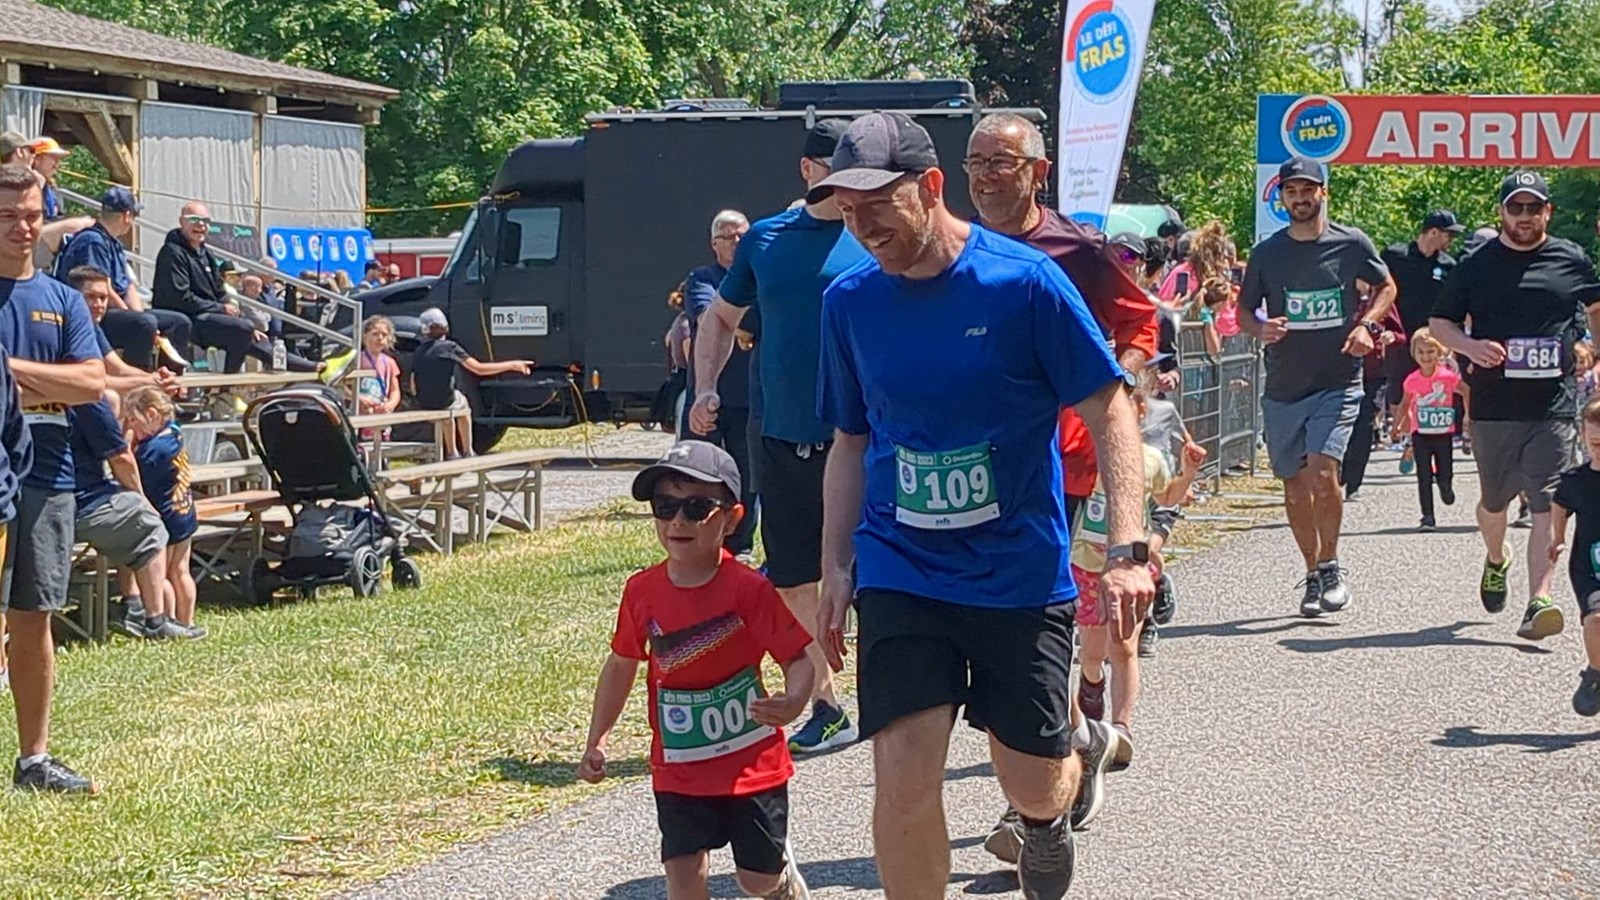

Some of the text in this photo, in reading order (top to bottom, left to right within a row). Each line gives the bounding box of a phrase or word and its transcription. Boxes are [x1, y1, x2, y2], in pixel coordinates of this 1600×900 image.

[1080, 21, 1117, 47] LE DÉFI
[1079, 36, 1126, 74] FRAS
[1299, 124, 1338, 142] FRAS
[1301, 118, 1311, 127] LE
[1306, 298, 1338, 320] 122
[1527, 346, 1560, 368] 684
[1430, 411, 1453, 427] 026
[924, 464, 989, 510] 109
